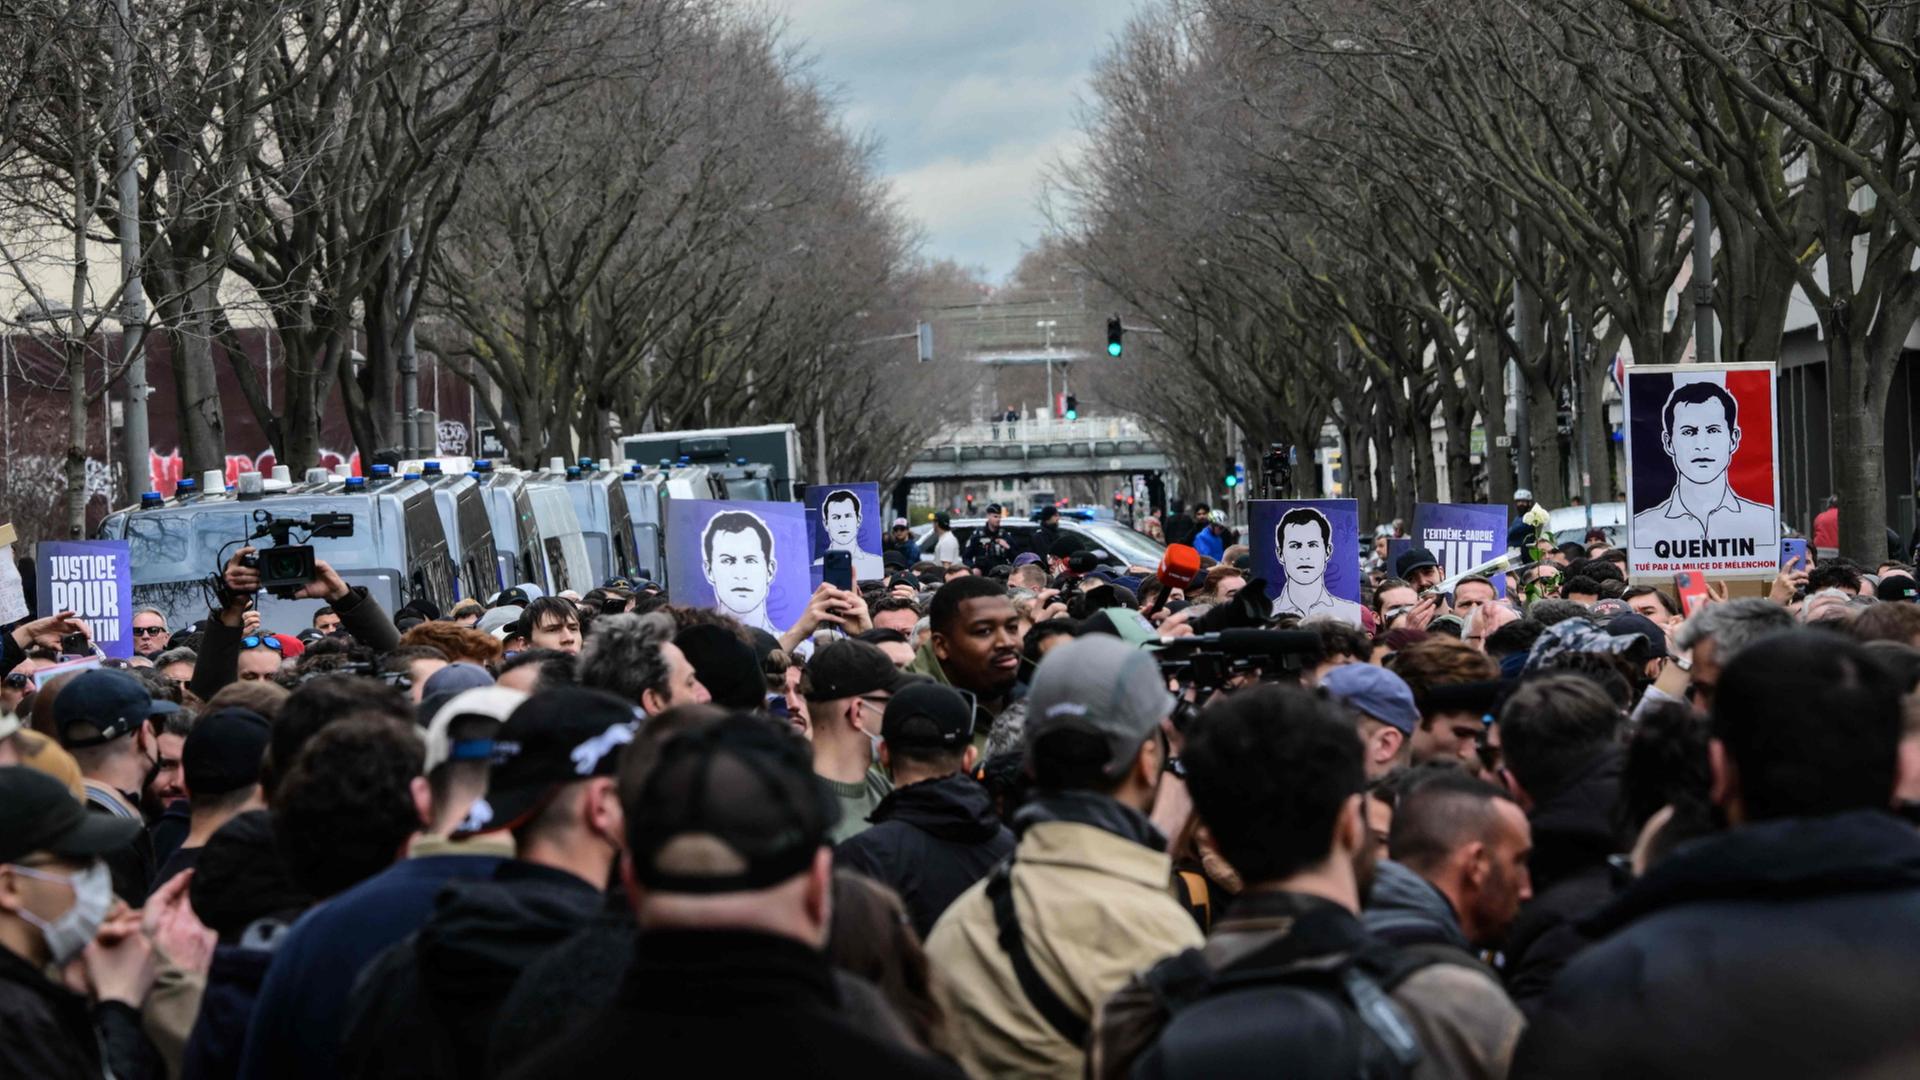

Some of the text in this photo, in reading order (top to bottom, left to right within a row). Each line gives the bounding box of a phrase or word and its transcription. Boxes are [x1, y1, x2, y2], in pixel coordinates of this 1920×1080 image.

[1423, 528, 1494, 541] L'EXTRÊME-GAUCHE
[1654, 538, 1755, 558] QUENTIN
[50, 555, 117, 580] JUSTICE
[1635, 562, 1650, 571] TUÉ
[1652, 563, 1668, 571] PAR
[1671, 563, 1681, 571] LA
[1682, 562, 1710, 571] MILICE
[1712, 562, 1723, 570] DE
[51, 581, 119, 618] POUR
